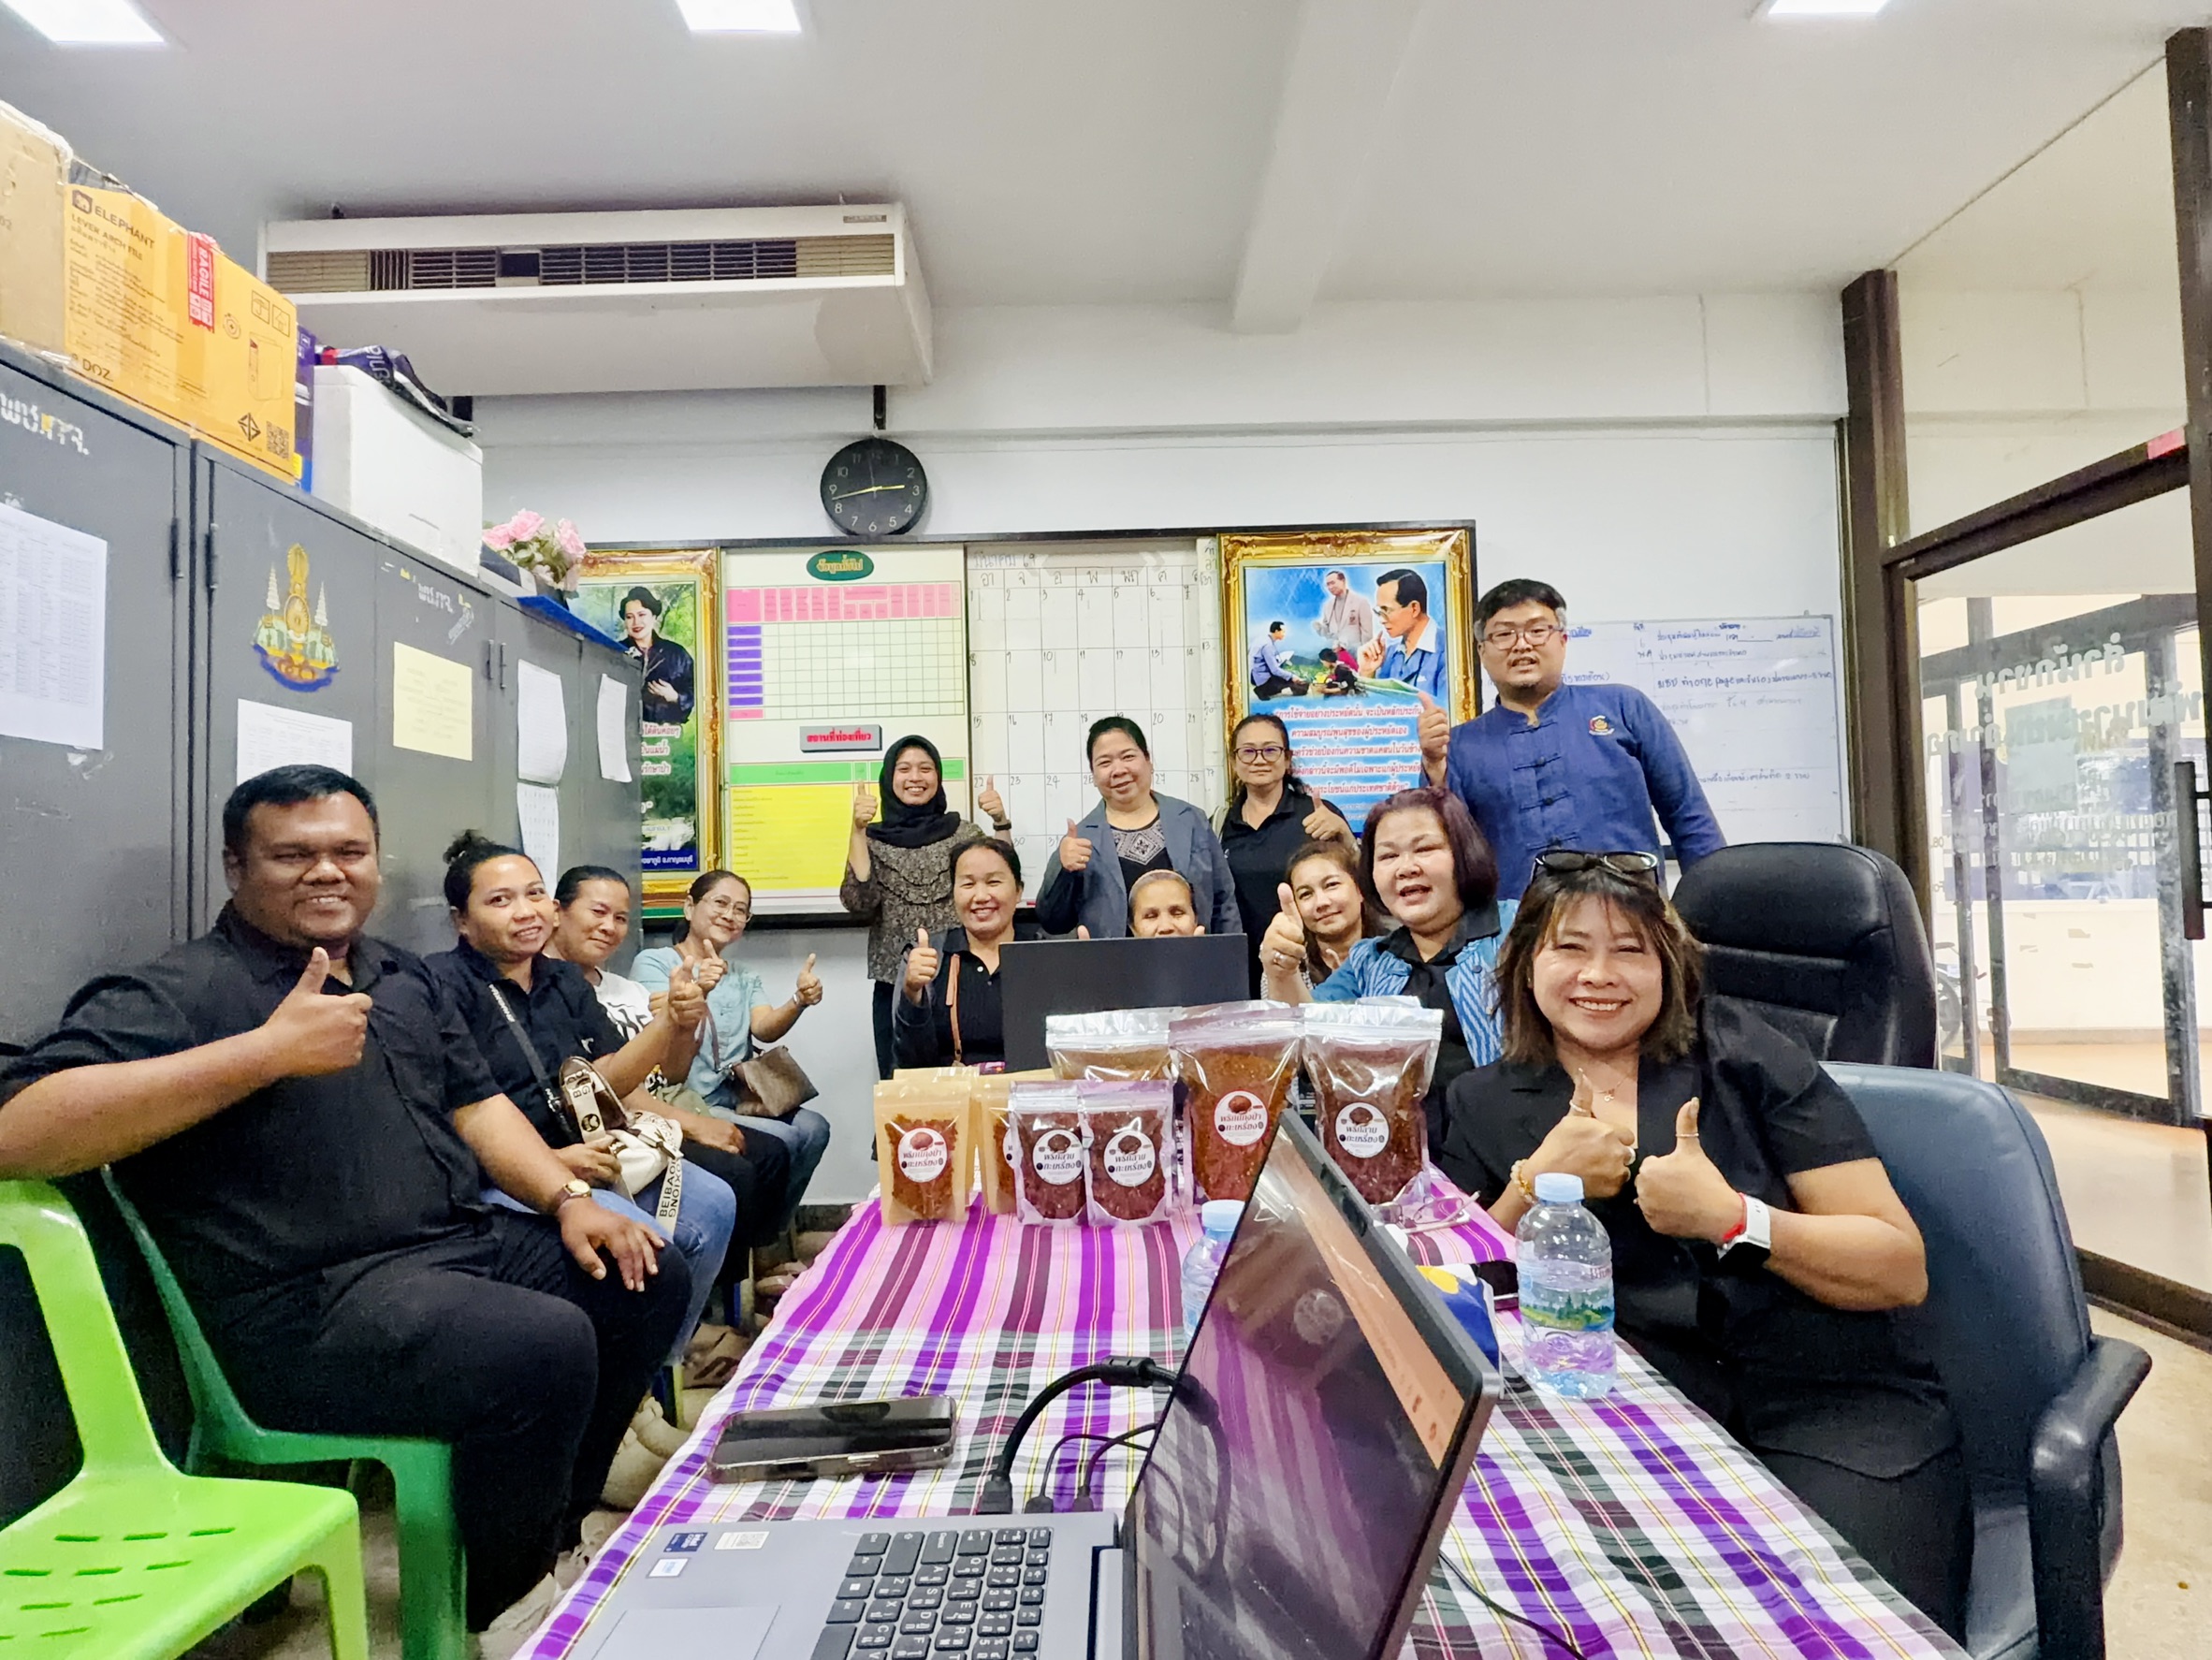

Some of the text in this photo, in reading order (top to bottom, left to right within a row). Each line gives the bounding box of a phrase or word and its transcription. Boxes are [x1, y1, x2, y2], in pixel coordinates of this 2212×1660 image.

[71, 213, 100, 235] LEVER
[95, 205, 155, 250] ELEPHANT
[197, 243, 211, 299] RAGILE
[837, 467, 849, 478] 10
[907, 467, 915, 479] 2
[828, 484, 837, 495] 9
[911, 485, 921, 497] 3
[834, 502, 843, 515] 8
[904, 503, 912, 515] 4
[851, 516, 859, 527] 7
[868, 521, 878, 532] 6
[888, 516, 897, 528] 5
[1006, 588, 1011, 602] 2
[1041, 589, 1048, 601] 3
[1077, 589, 1085, 601] 4
[1113, 587, 1120, 599] 5
[1044, 650, 1054, 662] 10
[973, 714, 982, 727] 15
[1044, 713, 1054, 726] 17
[1152, 712, 1164, 725] 20
[1187, 712, 1197, 724] 21
[807, 726, 873, 743] สถานที่ท่องเที่ยว
[973, 776, 984, 788] 22
[1011, 775, 1022, 786] 23
[1046, 775, 1061, 790] 24
[1155, 771, 1167, 785] 27
[1189, 771, 1201, 783] 28
[966, 1579, 977, 1588] W
[954, 1626, 967, 1635] R
